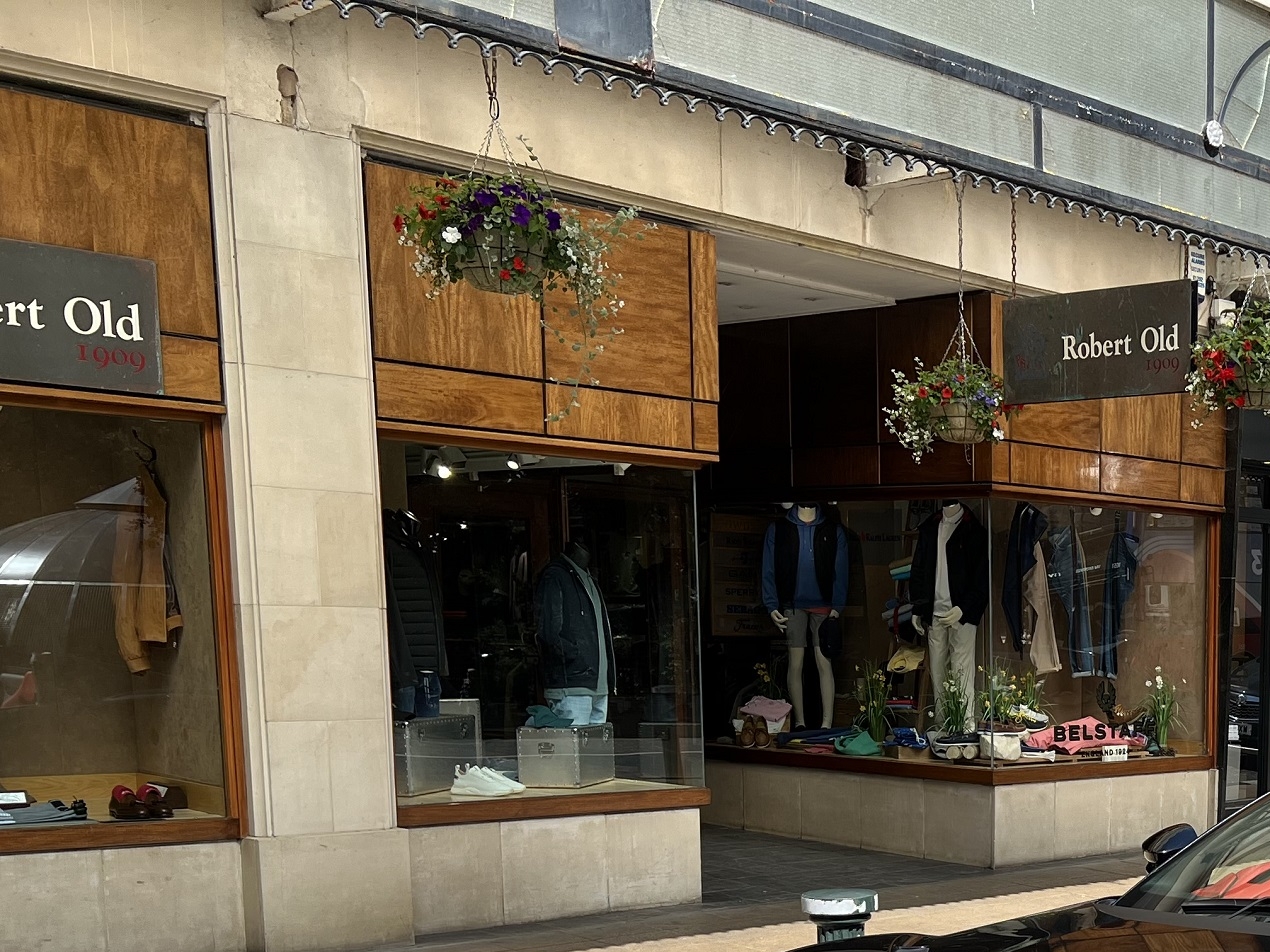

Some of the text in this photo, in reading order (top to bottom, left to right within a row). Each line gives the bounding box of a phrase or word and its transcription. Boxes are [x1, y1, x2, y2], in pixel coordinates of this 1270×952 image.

[64, 297, 144, 341] Old
[1062, 323, 1180, 360] Robert Old
[77, 344, 146, 374] 1909
[1146, 357, 1180, 375] 1909
